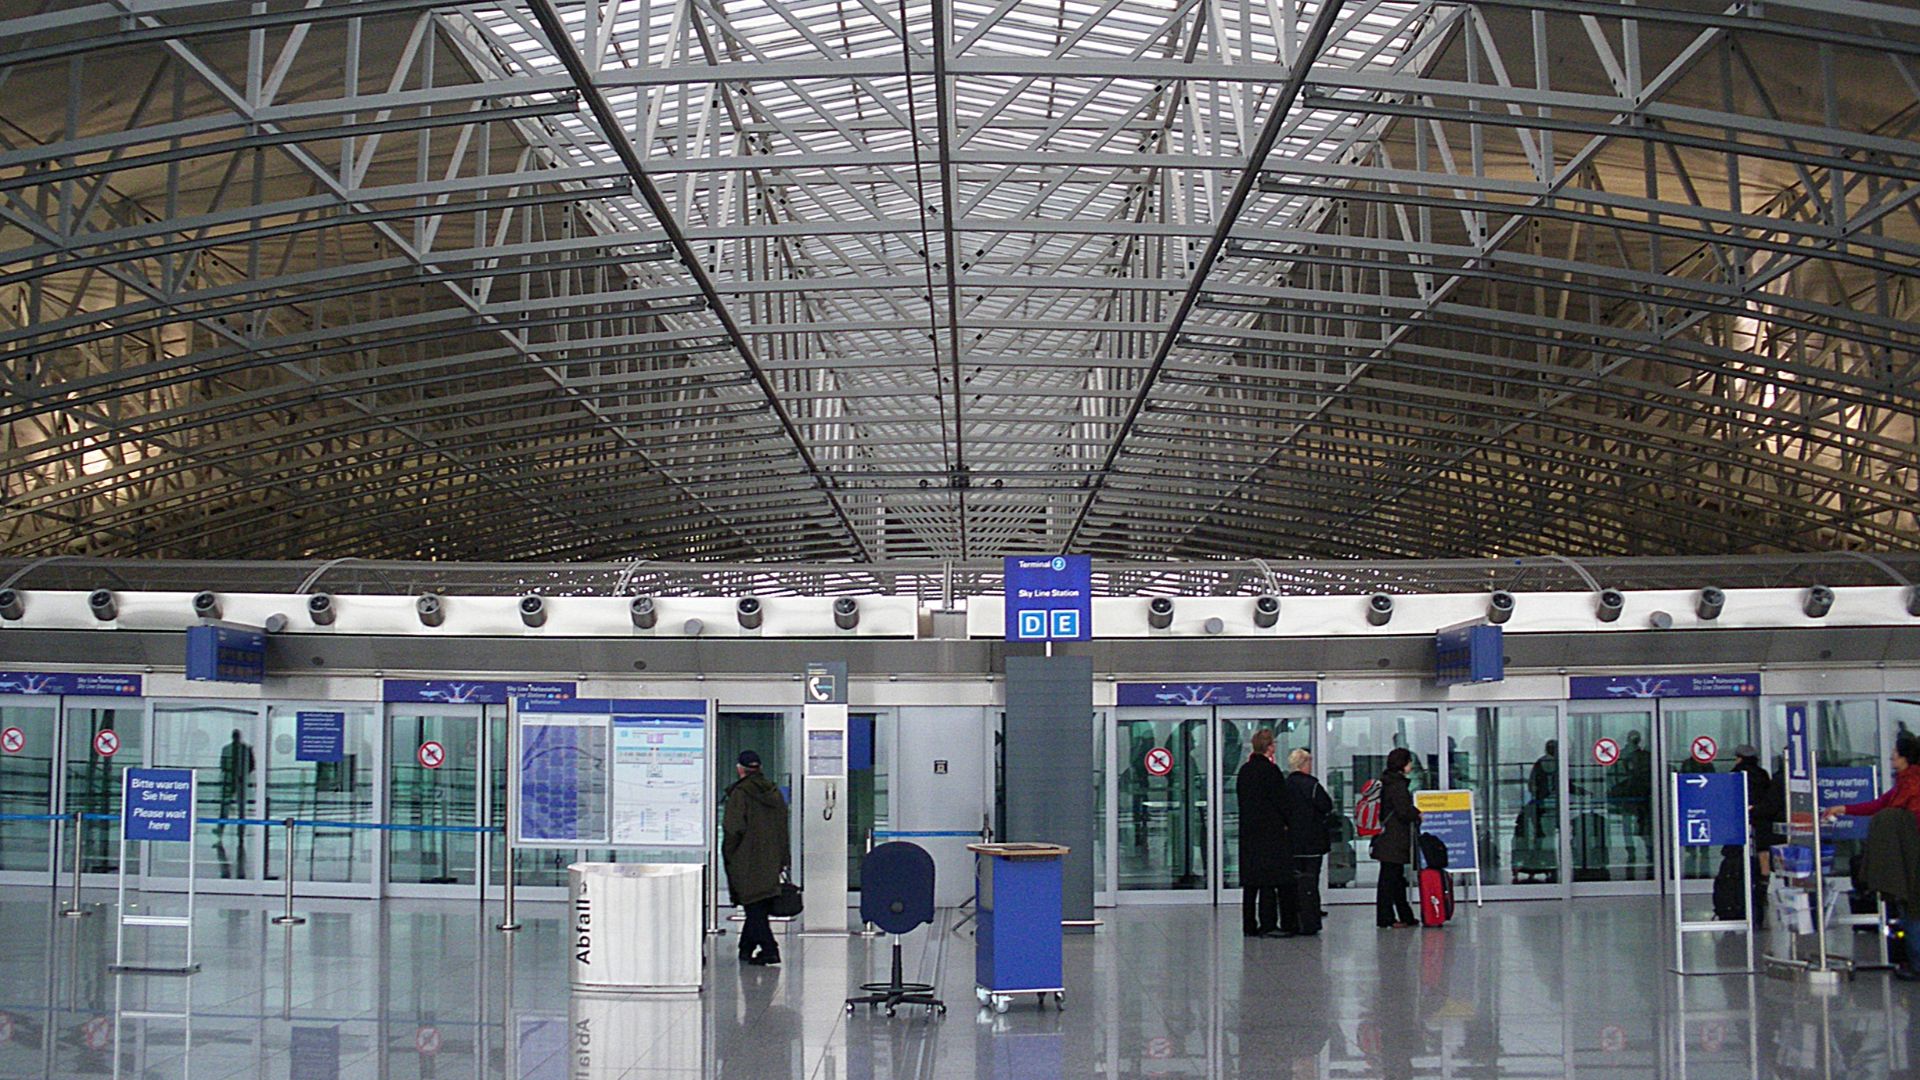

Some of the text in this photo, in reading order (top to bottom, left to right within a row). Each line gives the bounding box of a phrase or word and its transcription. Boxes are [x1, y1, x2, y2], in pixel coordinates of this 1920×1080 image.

[1018, 560, 1051, 568] Terminal
[1018, 589, 1080, 598] Sky Line Station
[1025, 615, 1071, 633] D E
[131, 778, 189, 790] Bitte warten
[1818, 778, 1868, 787] itte warten
[142, 790, 178, 801] Sie hier
[1824, 788, 1859, 799] Sie hier
[133, 807, 187, 819] Please wait
[148, 820, 171, 830] here
[576, 899, 590, 965] Abfall
